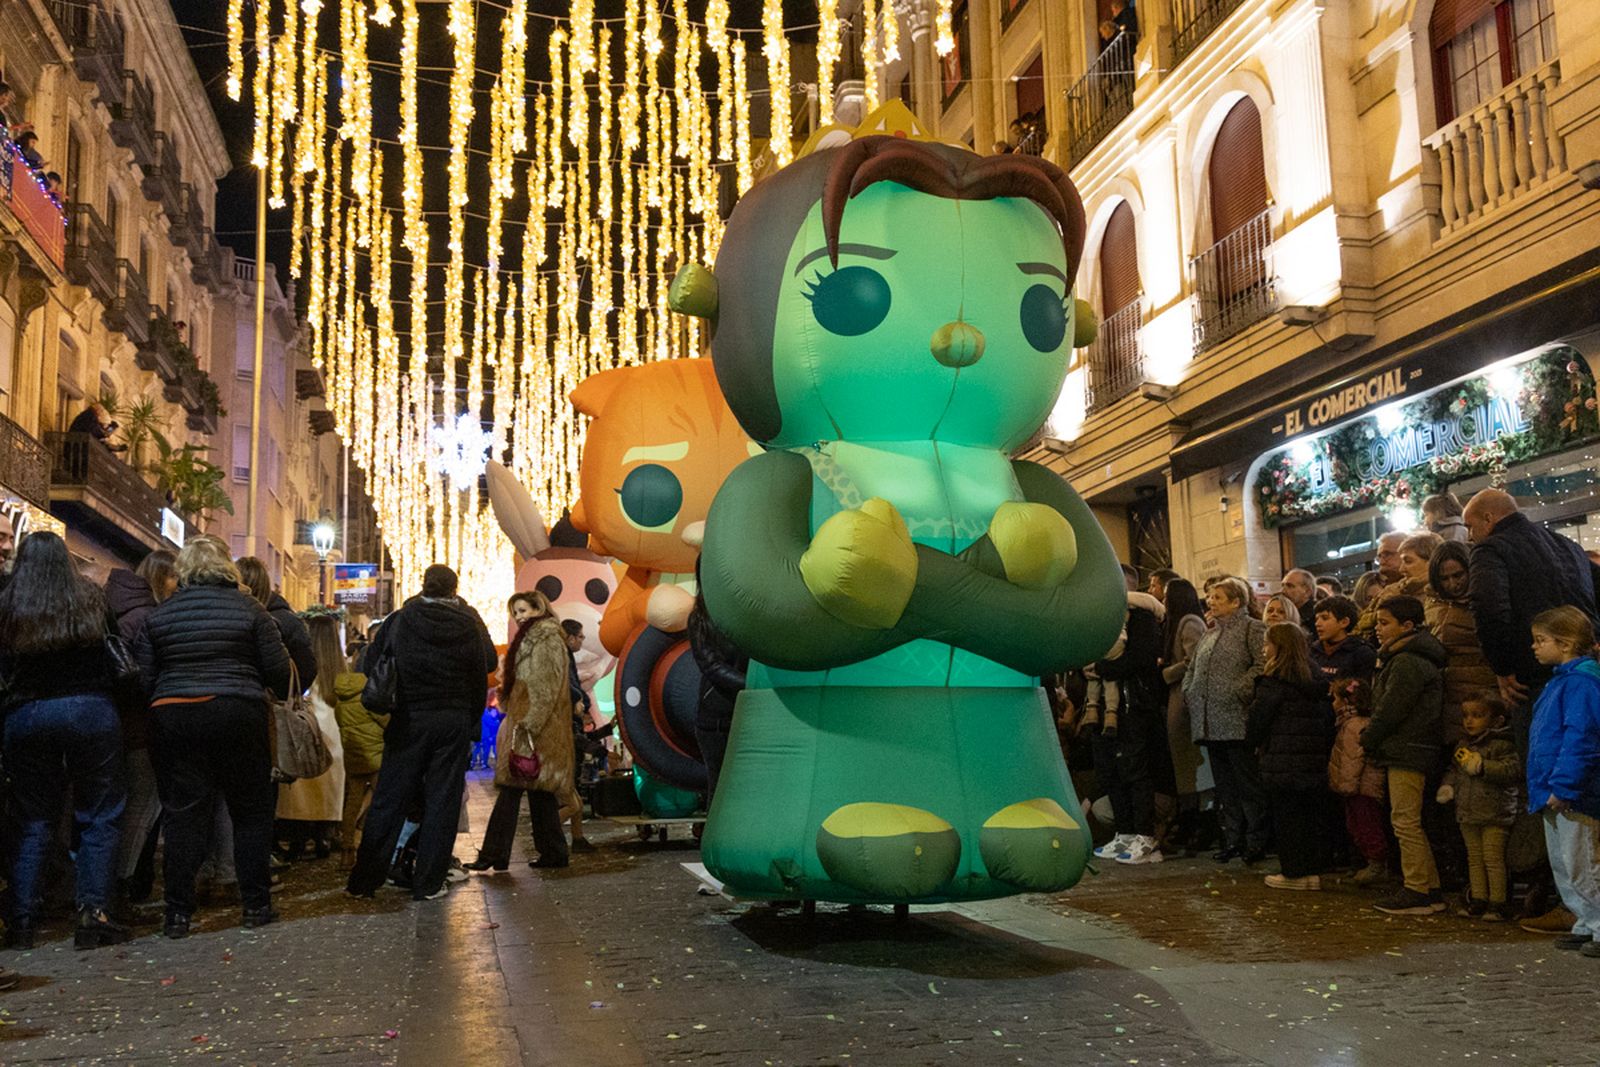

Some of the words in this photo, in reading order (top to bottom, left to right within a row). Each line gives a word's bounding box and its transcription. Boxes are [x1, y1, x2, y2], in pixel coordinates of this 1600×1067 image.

[1285, 408, 1304, 437] EL
[1308, 367, 1407, 426] COMERCIAL
[1354, 396, 1534, 481] COMERCIAL
